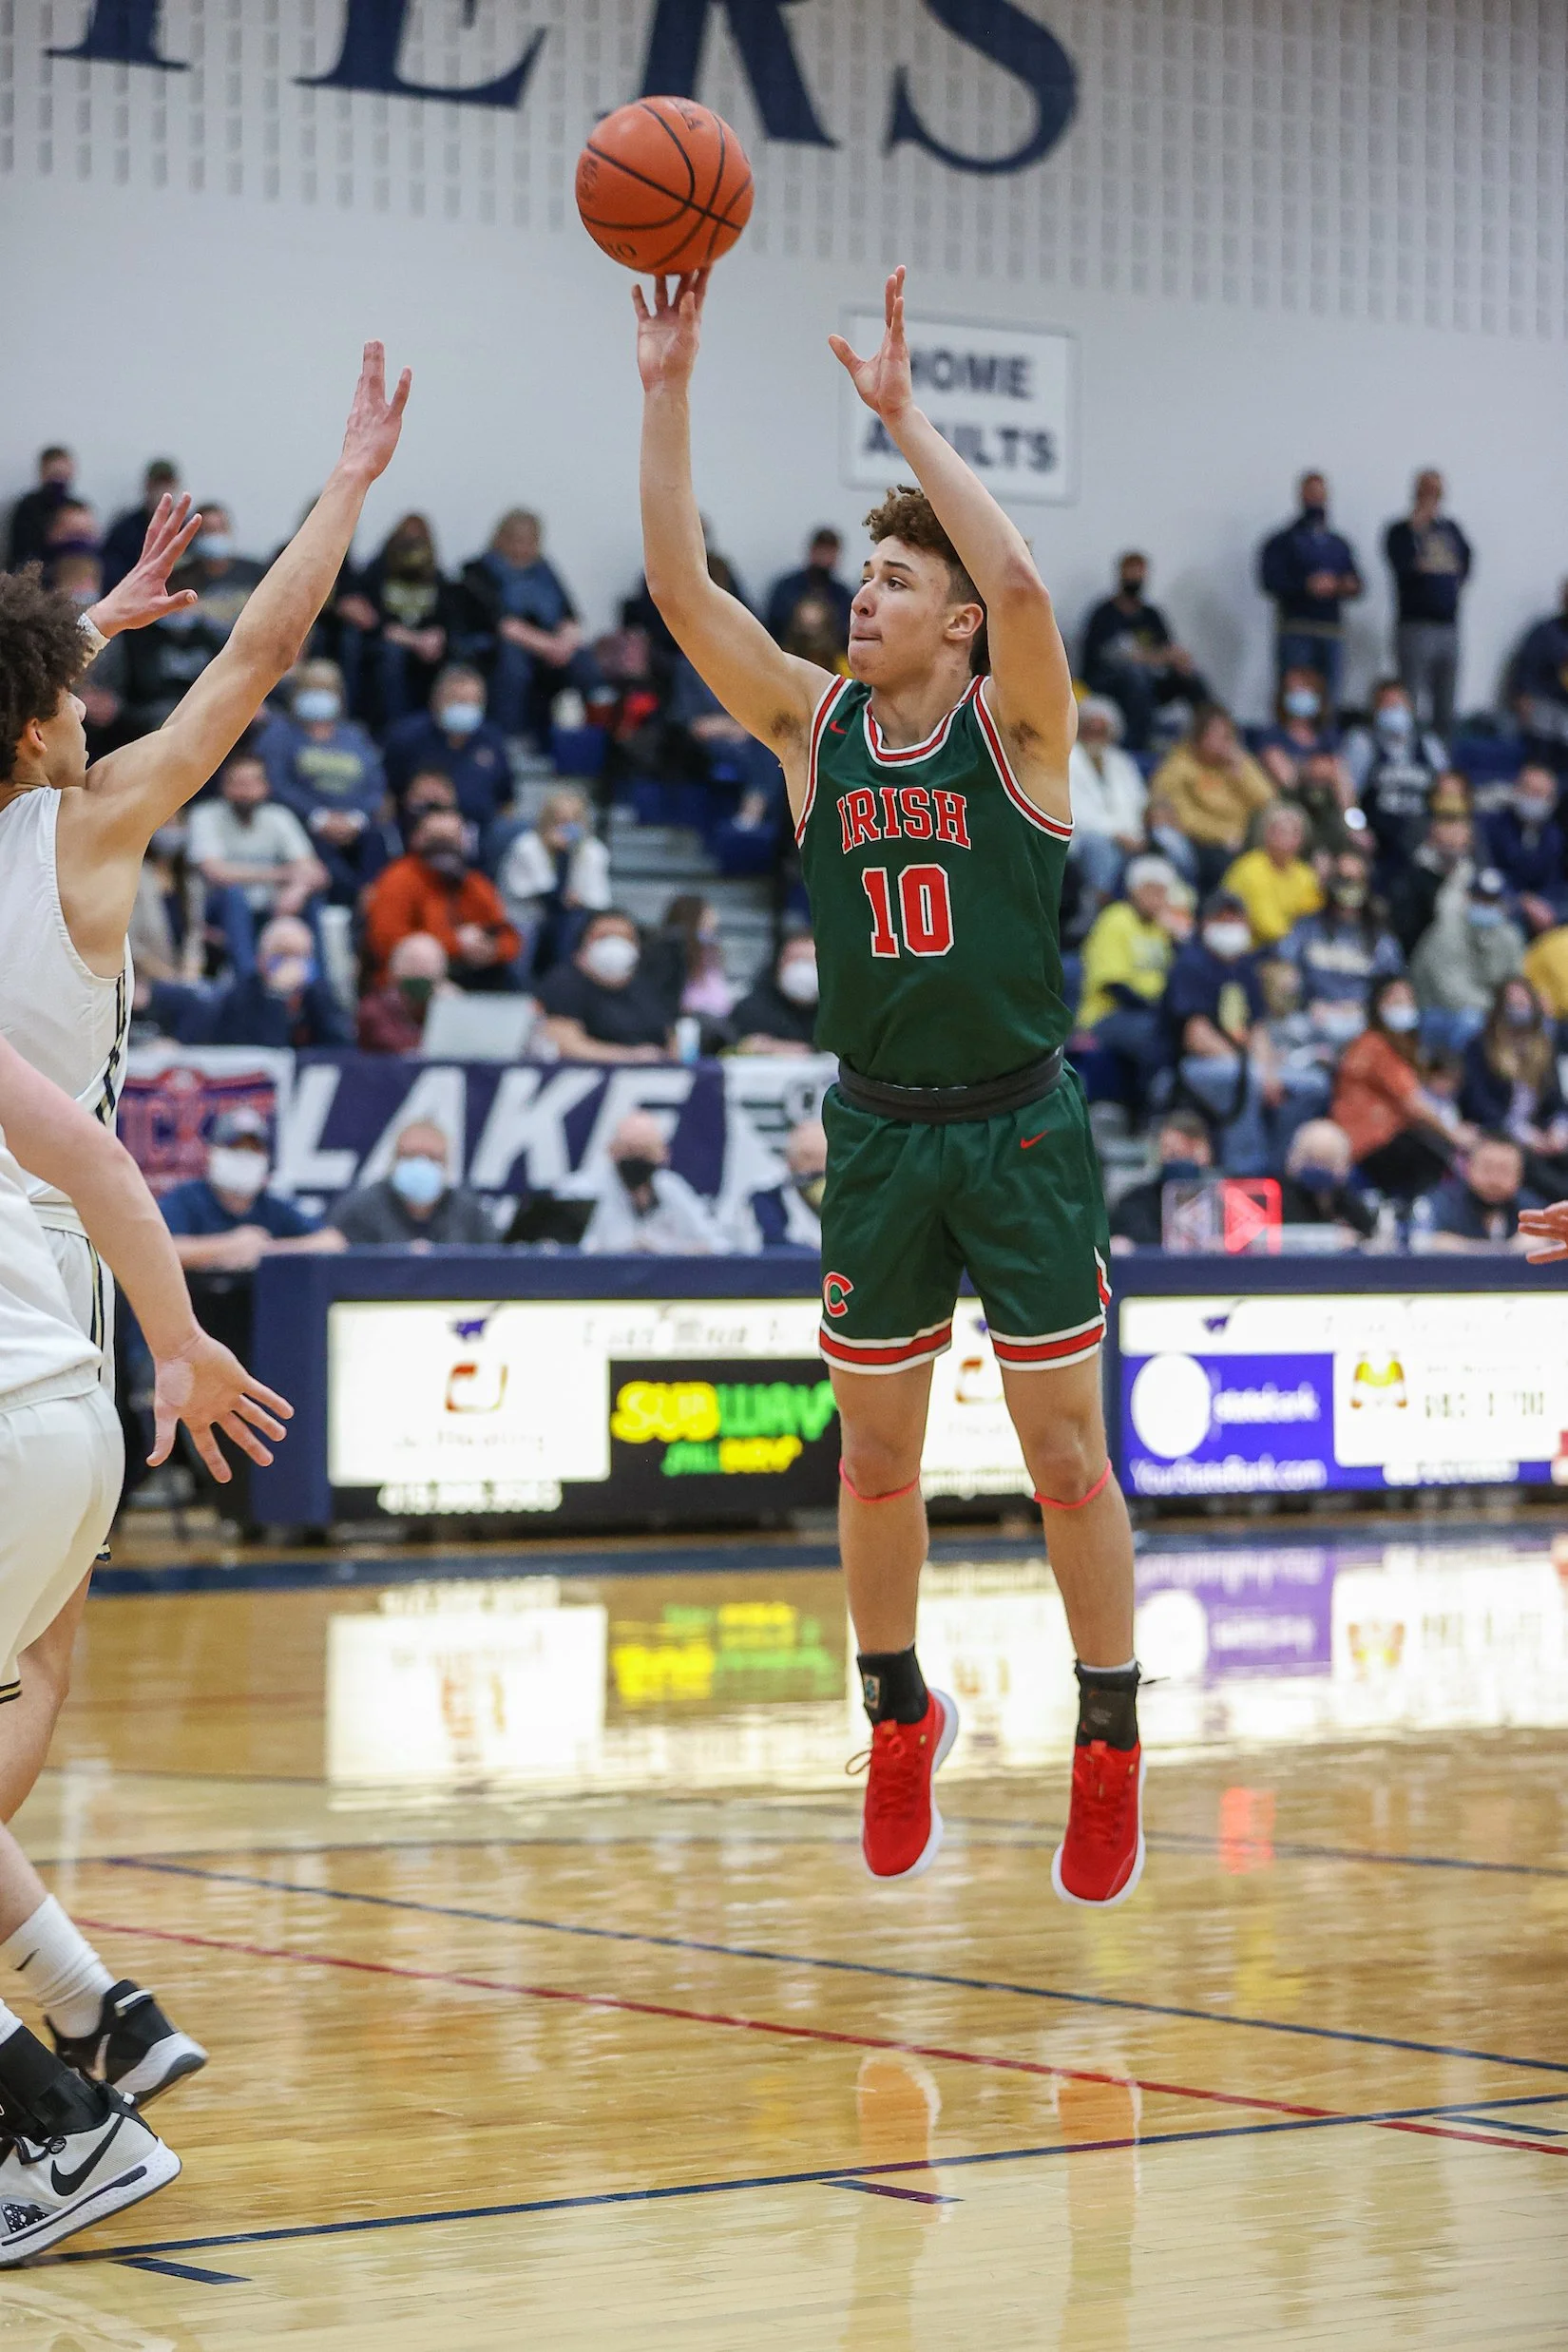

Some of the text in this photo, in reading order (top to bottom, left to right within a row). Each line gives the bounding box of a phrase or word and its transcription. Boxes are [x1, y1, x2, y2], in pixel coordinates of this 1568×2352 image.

[862, 414, 1059, 472] AULTS
[836, 787, 972, 854] IRISH
[861, 863, 955, 958] 10
[823, 1272, 854, 1318] C
